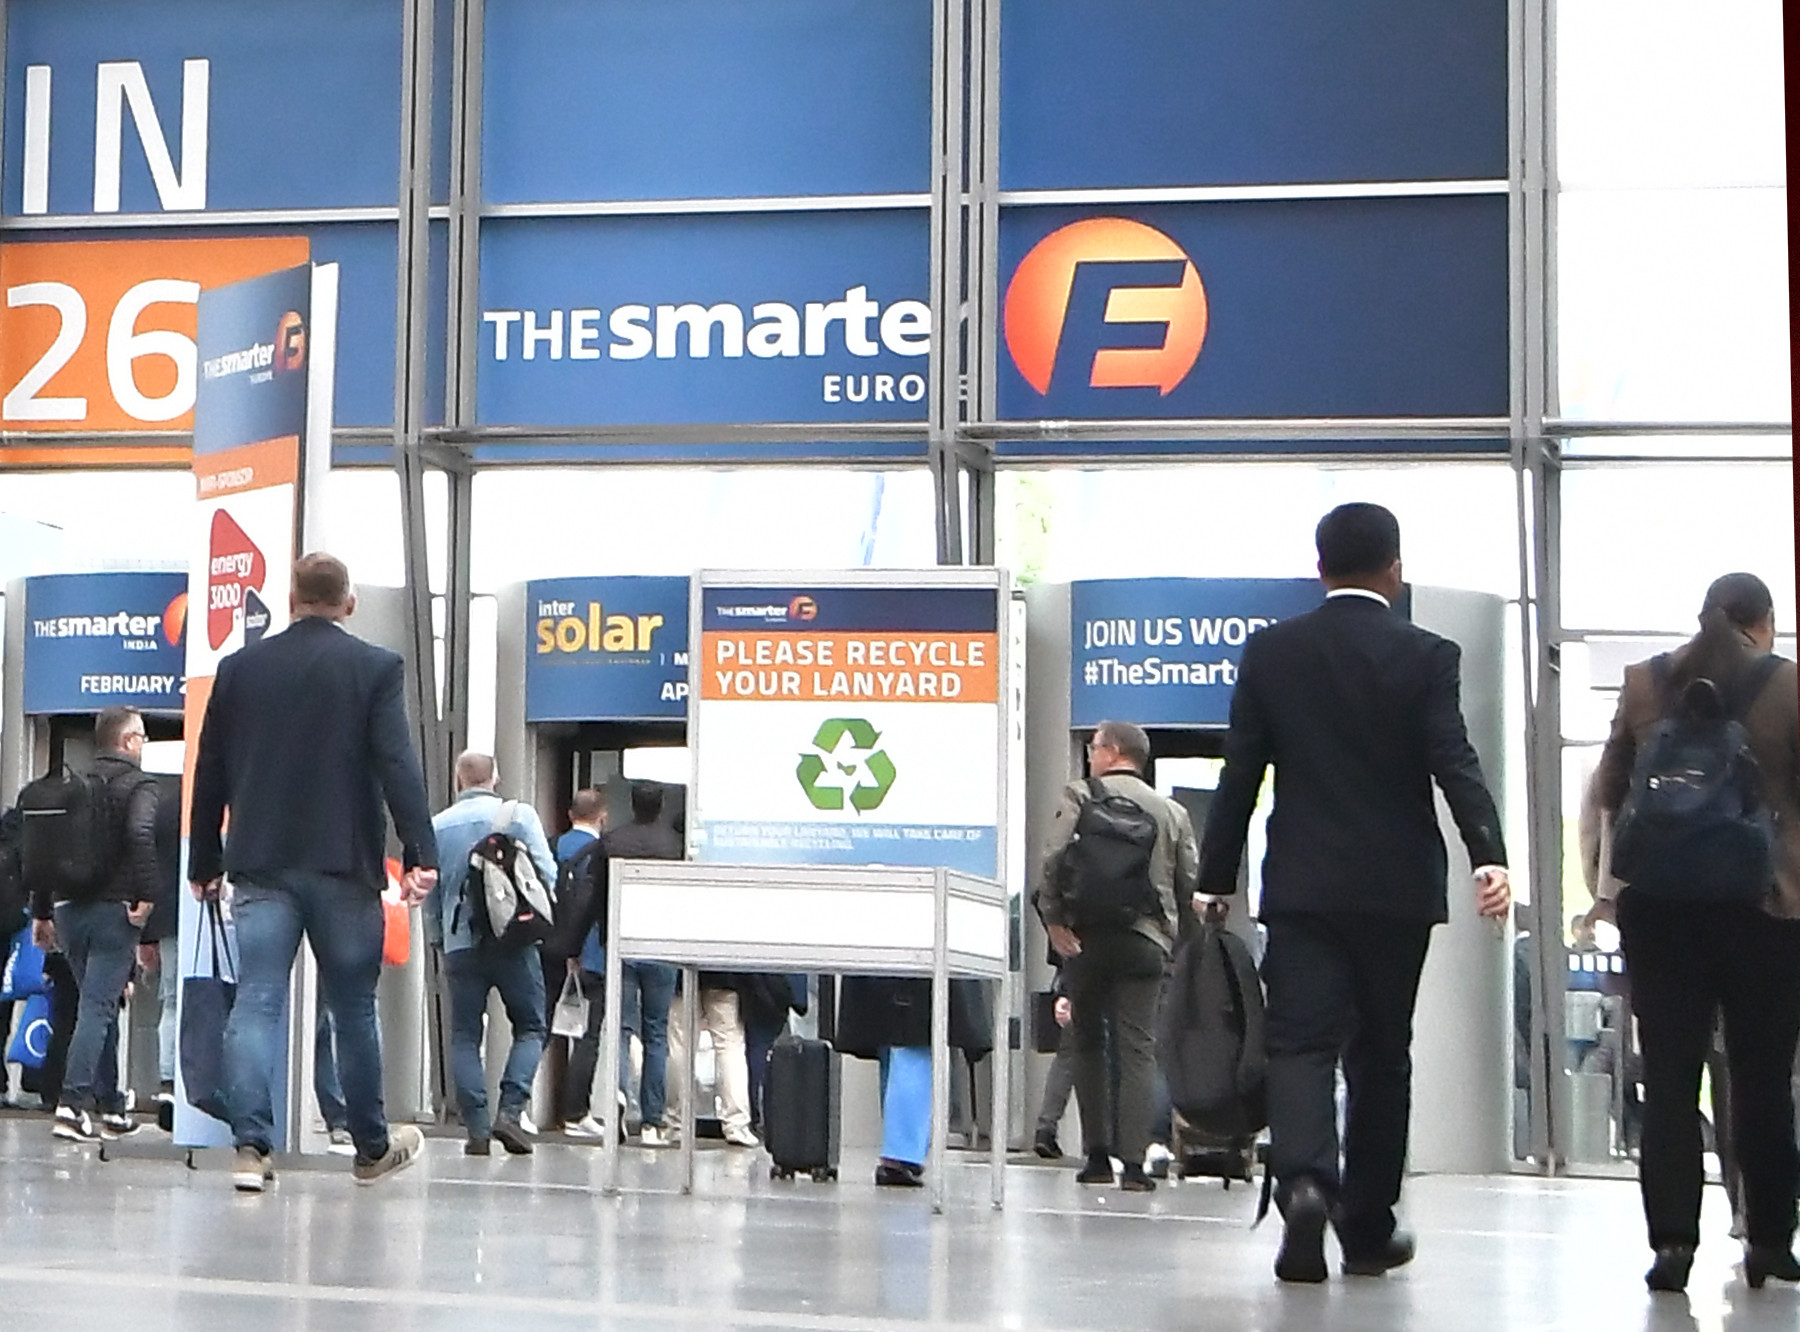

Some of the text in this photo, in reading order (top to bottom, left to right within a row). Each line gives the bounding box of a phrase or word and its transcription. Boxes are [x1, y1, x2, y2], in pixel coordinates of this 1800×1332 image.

[211, 552, 253, 578] energy
[210, 582, 241, 610] 3000
[538, 600, 576, 616] inter
[536, 602, 664, 653] solar
[1084, 619, 1136, 650] JOIN
[1144, 618, 1183, 646] US
[123, 639, 158, 651] INDIA
[716, 640, 986, 667] PLEASE RECYCLE
[81, 675, 175, 694] FEBRUARY
[715, 670, 962, 698] YOUR LANYARD
